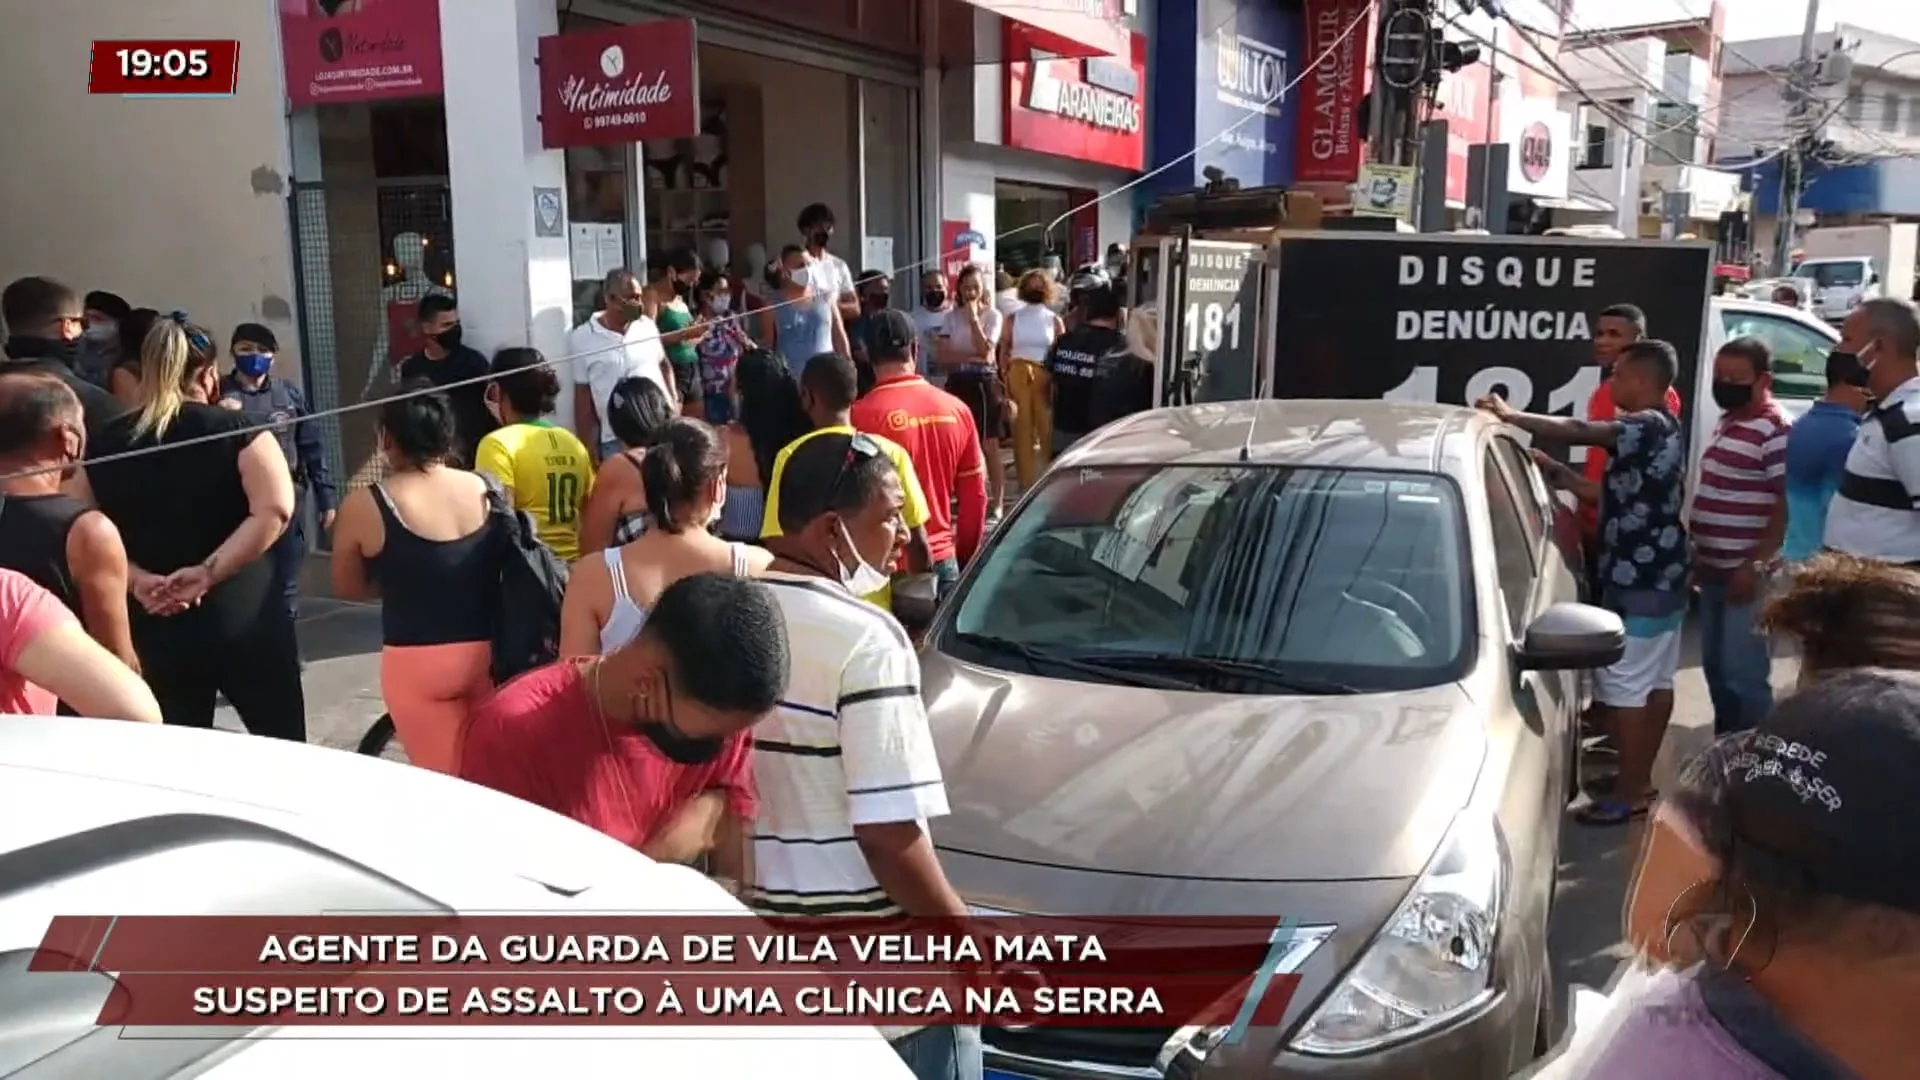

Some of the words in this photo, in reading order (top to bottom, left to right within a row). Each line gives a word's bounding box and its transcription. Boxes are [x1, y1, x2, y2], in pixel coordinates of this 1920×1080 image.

[1311, 8, 1341, 161] GLAMOUR
[1189, 253, 1243, 270] DISQUE
[1398, 255, 1597, 288] DISQUE
[1184, 302, 1241, 352] 181
[1396, 303, 1592, 340] DENÚNCIA
[547, 472, 579, 526] 10
